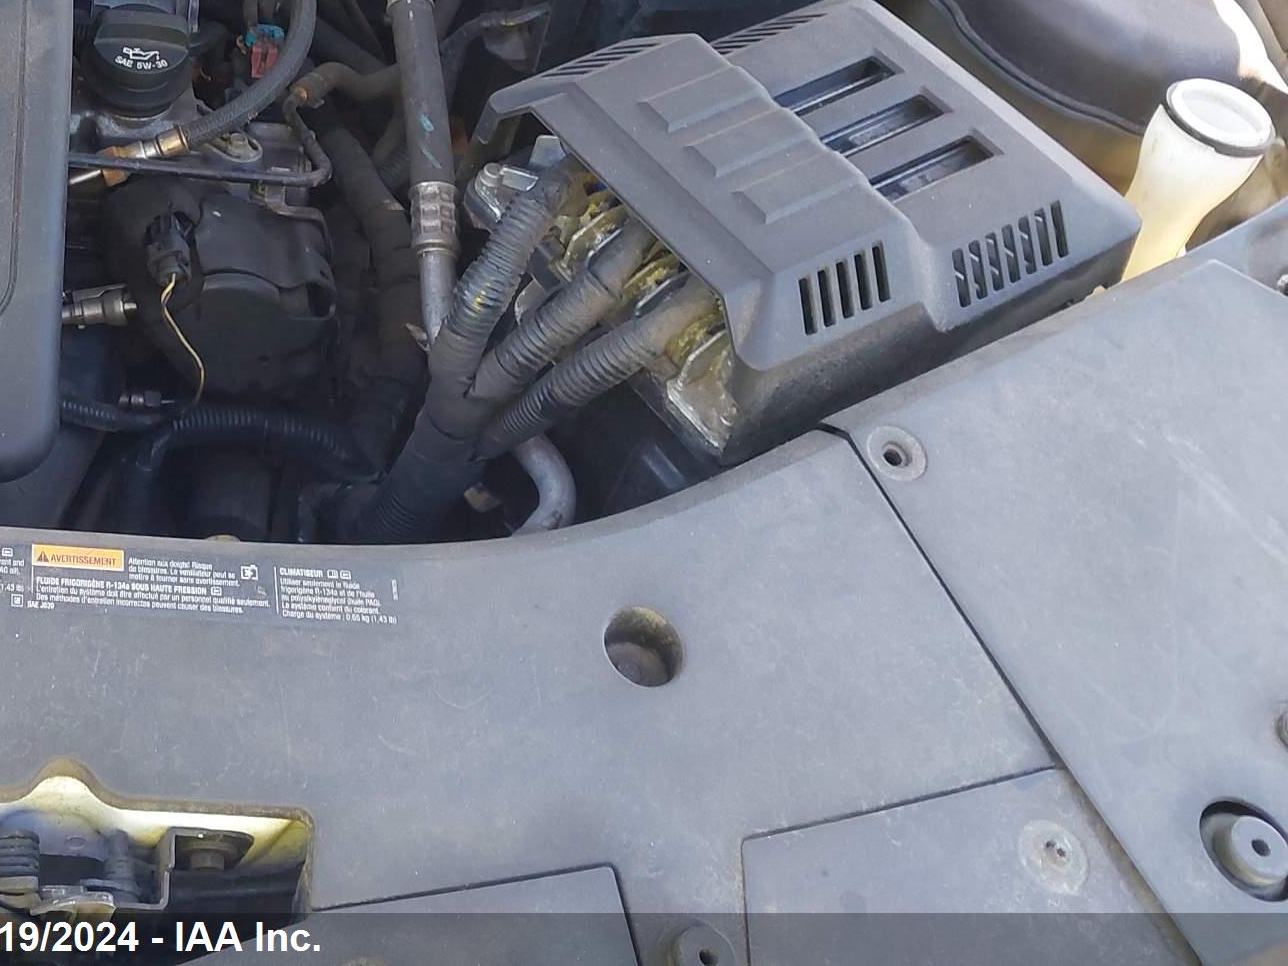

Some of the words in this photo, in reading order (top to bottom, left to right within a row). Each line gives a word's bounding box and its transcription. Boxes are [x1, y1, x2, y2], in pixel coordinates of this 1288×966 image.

[115, 55, 133, 67] SAE
[137, 59, 168, 70] 5W-30
[51, 554, 116, 566] AVERTISSEMENT
[128, 557, 156, 567] Attention
[129, 565, 136, 573] de
[179, 570, 211, 578] ventilateur
[279, 568, 323, 578] CLIMATISEUR
[36, 576, 59, 585] FLUIDE
[151, 584, 172, 593] HAUTE
[174, 586, 207, 595] PRESSION
[180, 576, 194, 584] sans
[70, 587, 78, 595] du
[160, 592, 170, 601] par
[182, 594, 211, 603] personnel
[37, 593, 48, 601] Des
[116, 598, 150, 607] incorrectes
[152, 601, 176, 610] peuvent
[200, 604, 211, 612] des
[282, 610, 304, 619] Charge
[306, 611, 314, 619] du
